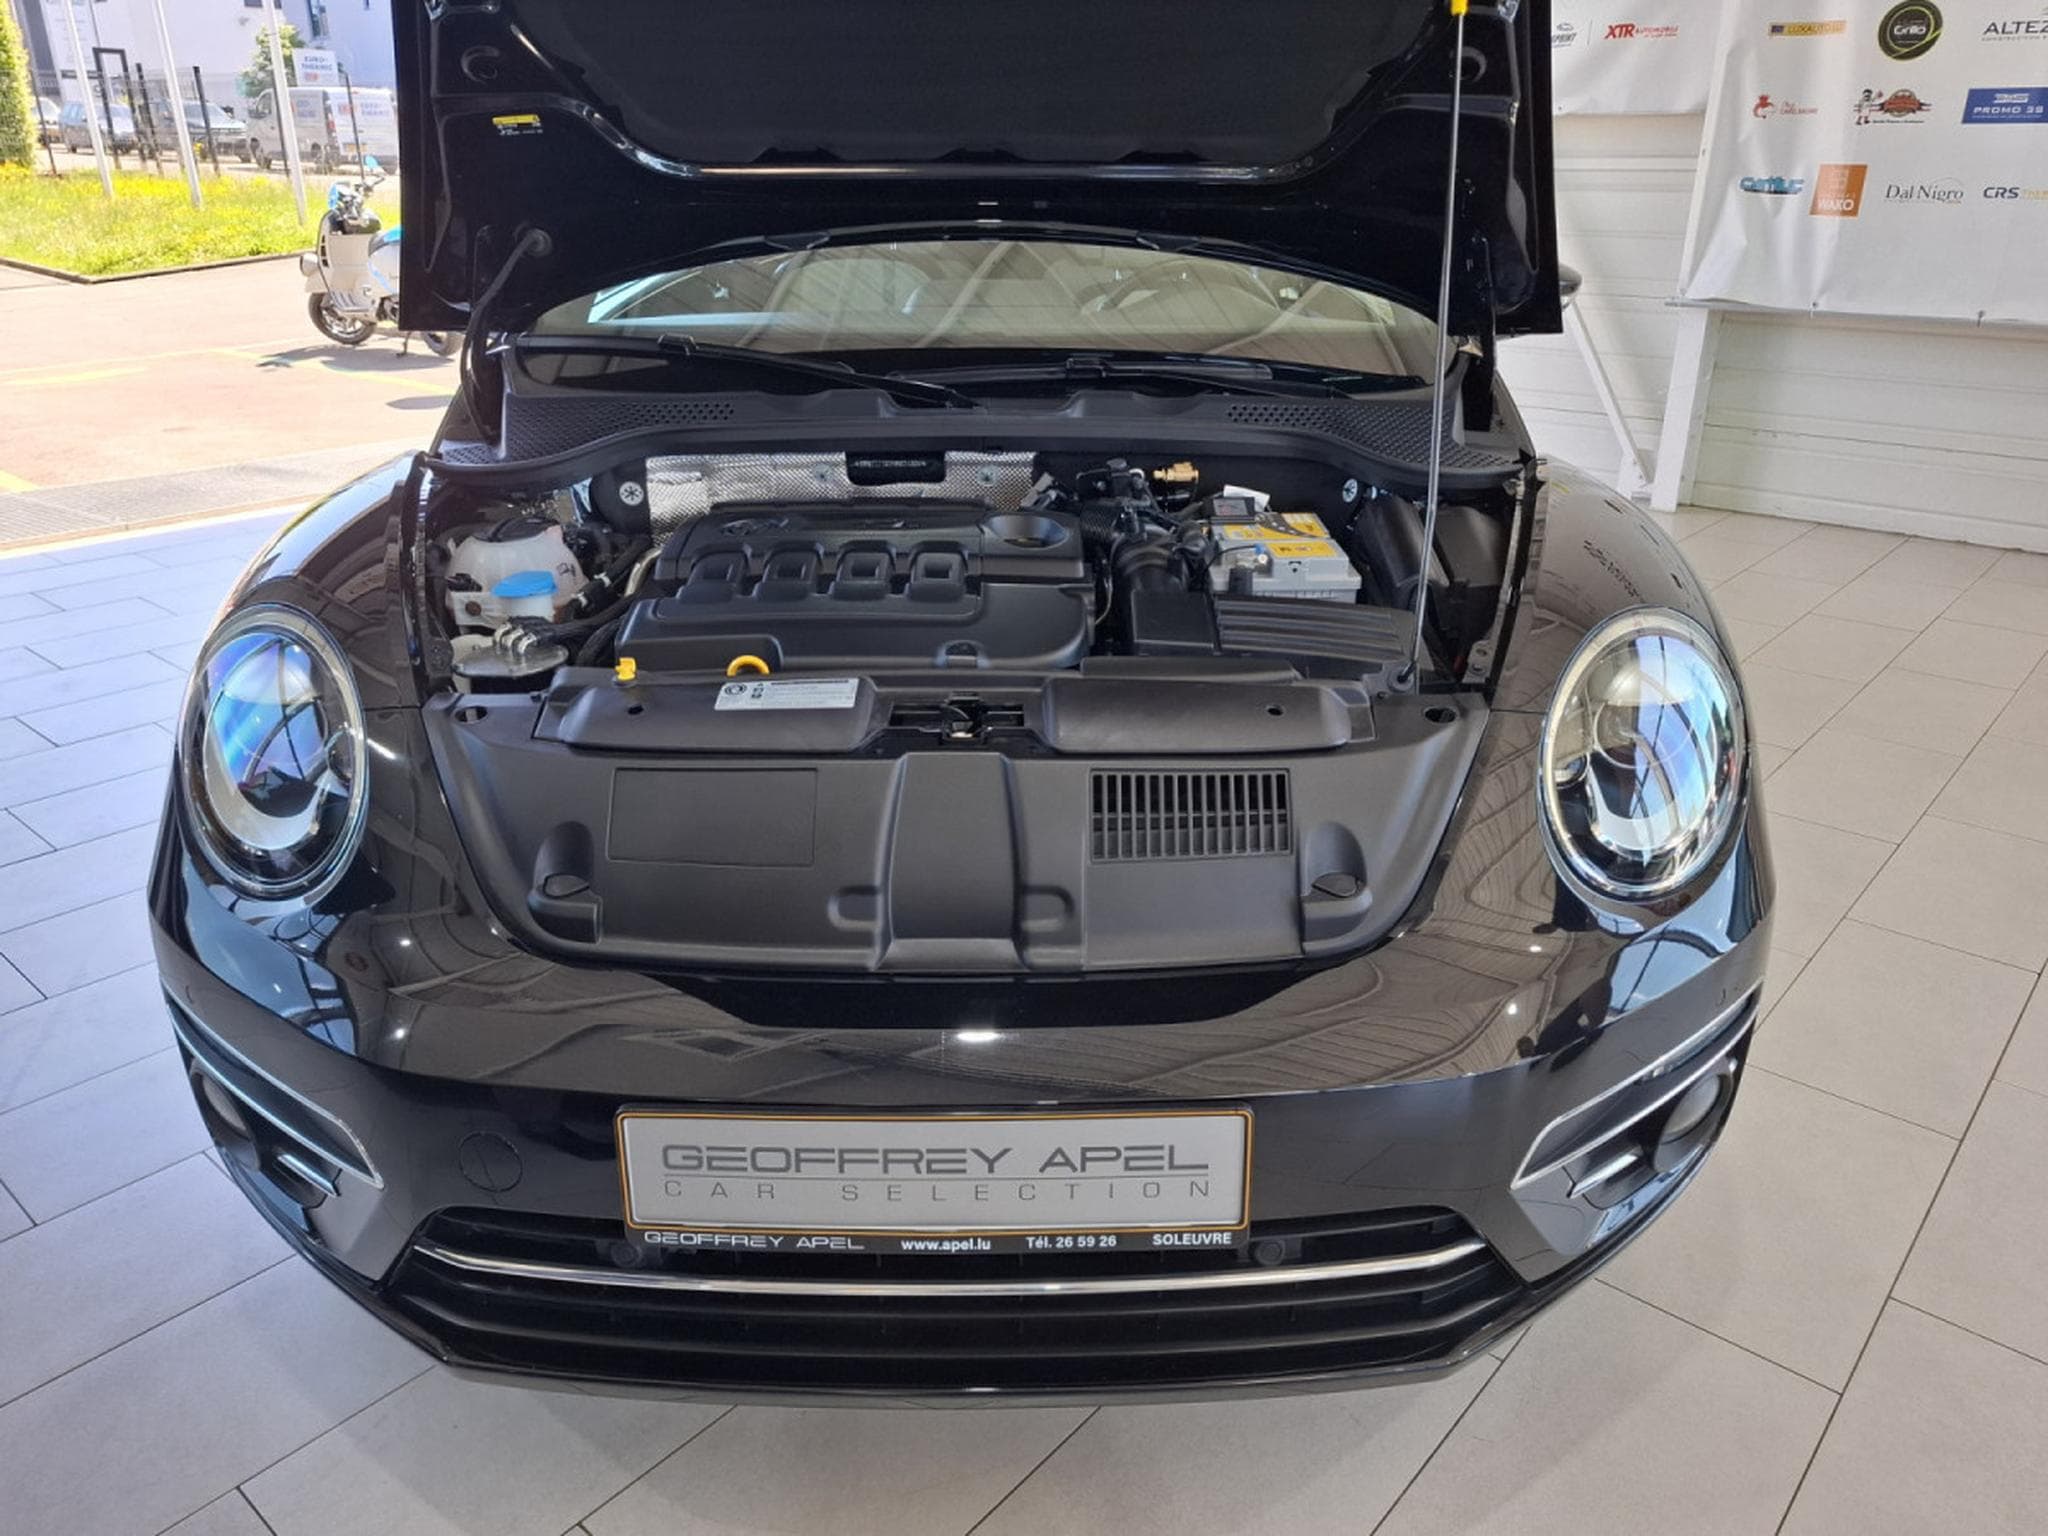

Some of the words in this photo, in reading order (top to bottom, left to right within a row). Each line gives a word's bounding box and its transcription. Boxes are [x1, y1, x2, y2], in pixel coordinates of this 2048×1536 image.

[1605, 23, 1636, 39] XTR
[1973, 106, 2021, 114] PROMO
[1885, 184, 1914, 199] Dal
[1917, 185, 1964, 202] Nigro
[1983, 187, 2020, 199] CRS
[662, 1144, 1013, 1175] GEOFFREY
[1038, 1144, 1209, 1173] APEL
[664, 1180, 776, 1200] CAR
[842, 1181, 1209, 1202] SELECTION
[644, 1231, 784, 1249] GEOFFREY
[796, 1236, 865, 1250] APEL
[901, 1237, 991, 1252] www.apel.lu
[1026, 1236, 1052, 1249] Tél.
[1055, 1236, 1073, 1248] 26
[1077, 1236, 1095, 1248] 59
[1099, 1235, 1117, 1248] 26
[1152, 1232, 1232, 1247] SOLEUVRE
